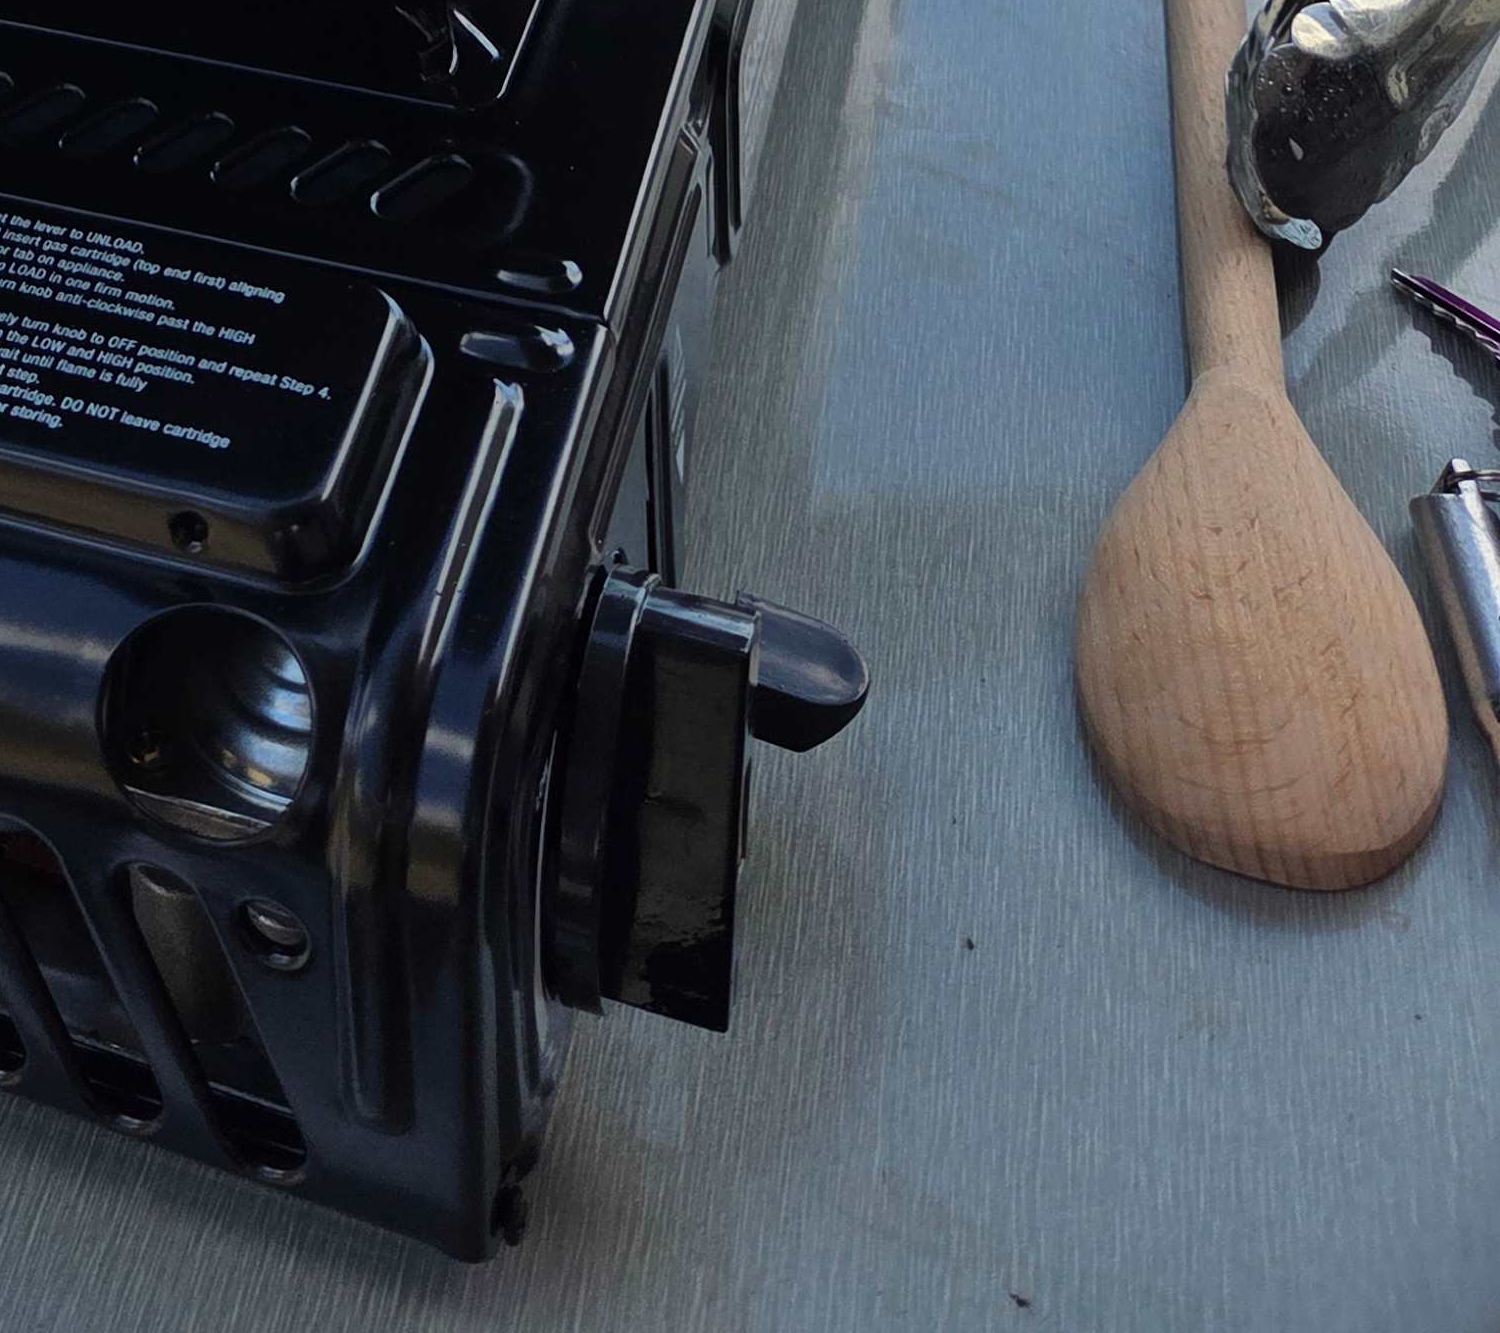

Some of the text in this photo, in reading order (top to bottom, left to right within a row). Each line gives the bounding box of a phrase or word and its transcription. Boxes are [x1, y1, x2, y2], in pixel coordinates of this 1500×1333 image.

[10, 215, 31, 228] the
[33, 220, 67, 236] lever
[69, 228, 84, 240] to
[86, 232, 143, 254] UNLOAD.
[3, 230, 41, 246] insert
[42, 240, 68, 252] gas
[70, 246, 131, 267] cartridge
[133, 259, 161, 274] (top
[163, 267, 191, 280] end
[228, 282, 285, 303] aligning
[8, 263, 46, 280] LOAD
[65, 277, 91, 290] one
[94, 282, 122, 297] firm
[125, 291, 174, 310] motion.
[6, 330, 29, 345] the
[31, 336, 66, 353] LOW
[66, 346, 95, 360] and
[97, 351, 134, 369] HIGH
[134, 362, 194, 384] position.
[60, 397, 84, 412] DO
[86, 403, 120, 420] NOT
[120, 411, 160, 431] leave
[163, 424, 230, 448] cartridge
